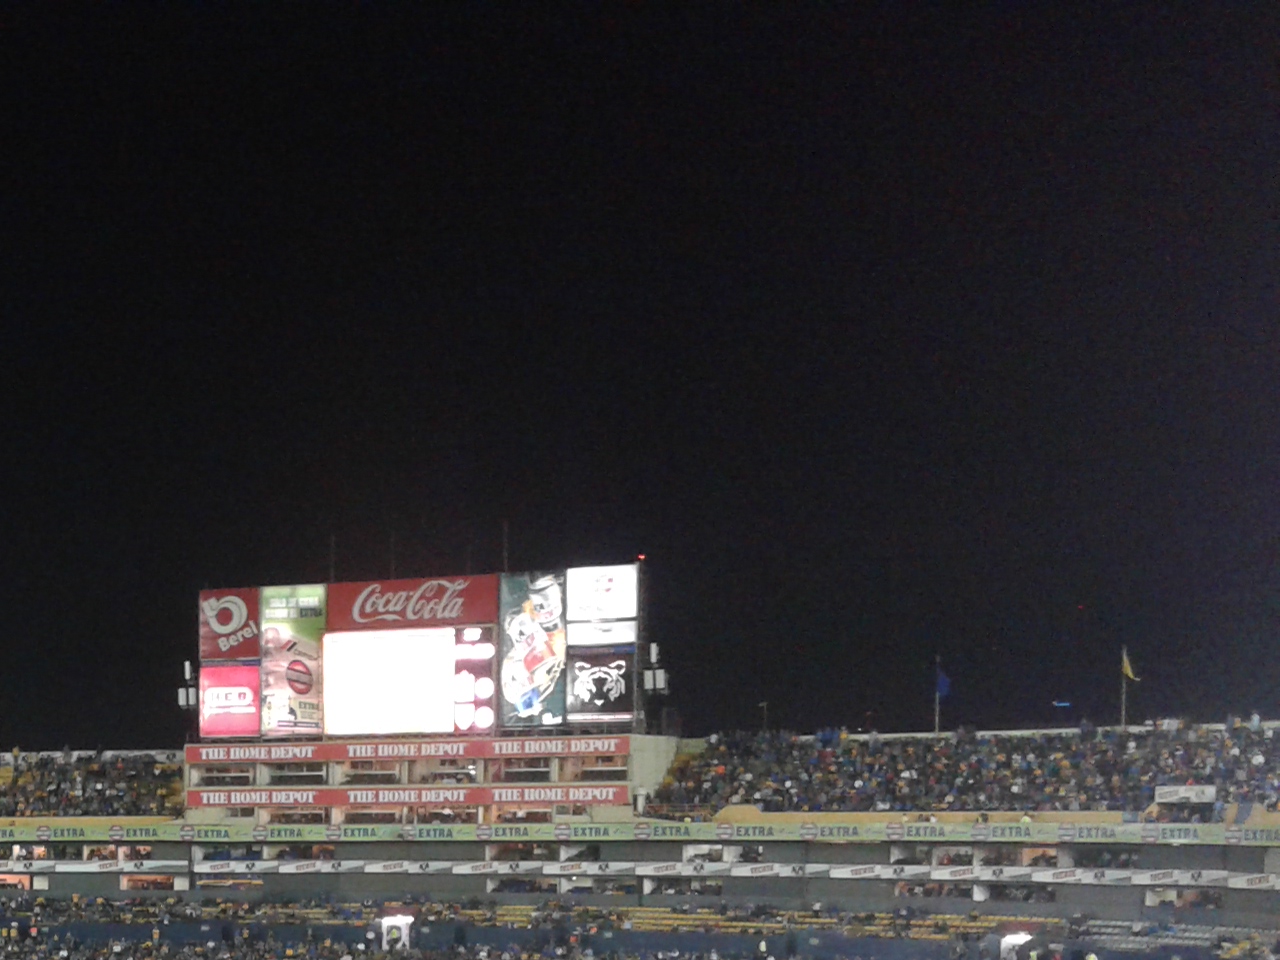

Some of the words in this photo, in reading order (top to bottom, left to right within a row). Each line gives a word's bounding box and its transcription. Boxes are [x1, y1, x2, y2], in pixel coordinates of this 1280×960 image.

[352, 580, 470, 623] Coca-Cola
[217, 619, 259, 652] Berel
[200, 747, 227, 759] THE
[230, 747, 269, 759] HOME
[271, 746, 317, 758] DEPOT
[347, 745, 375, 757] THE
[377, 744, 418, 756] HOME
[421, 743, 467, 755] DEPOT
[492, 742, 522, 754] THE
[524, 741, 567, 753] HOME
[571, 739, 618, 752] DEPOT
[200, 792, 227, 804] THE
[230, 792, 269, 804] HOME
[271, 791, 318, 803] DEPOT
[347, 791, 375, 803] THE
[378, 790, 419, 802] HOME
[421, 789, 467, 802] DEPOT
[492, 789, 522, 801] THE
[524, 788, 566, 800] HOME
[569, 787, 617, 799] DEPOT
[53, 828, 85, 838] EXTRA
[125, 828, 158, 838] EXTRA
[197, 829, 229, 839] EXTRA
[270, 829, 303, 838] EXTRA
[343, 827, 377, 838] EXTRA
[419, 828, 453, 838] EXTRA
[494, 827, 529, 838] EXTRA
[573, 827, 609, 838] EXTRA
[653, 826, 690, 837] EXTRA
[735, 826, 774, 837] EXTRA
[820, 826, 859, 838] EXTRA
[906, 826, 945, 838] EXTRA
[991, 827, 1032, 838] EXTRA
[1078, 827, 1117, 839] EXTRA
[1161, 827, 1199, 840] EXTRA
